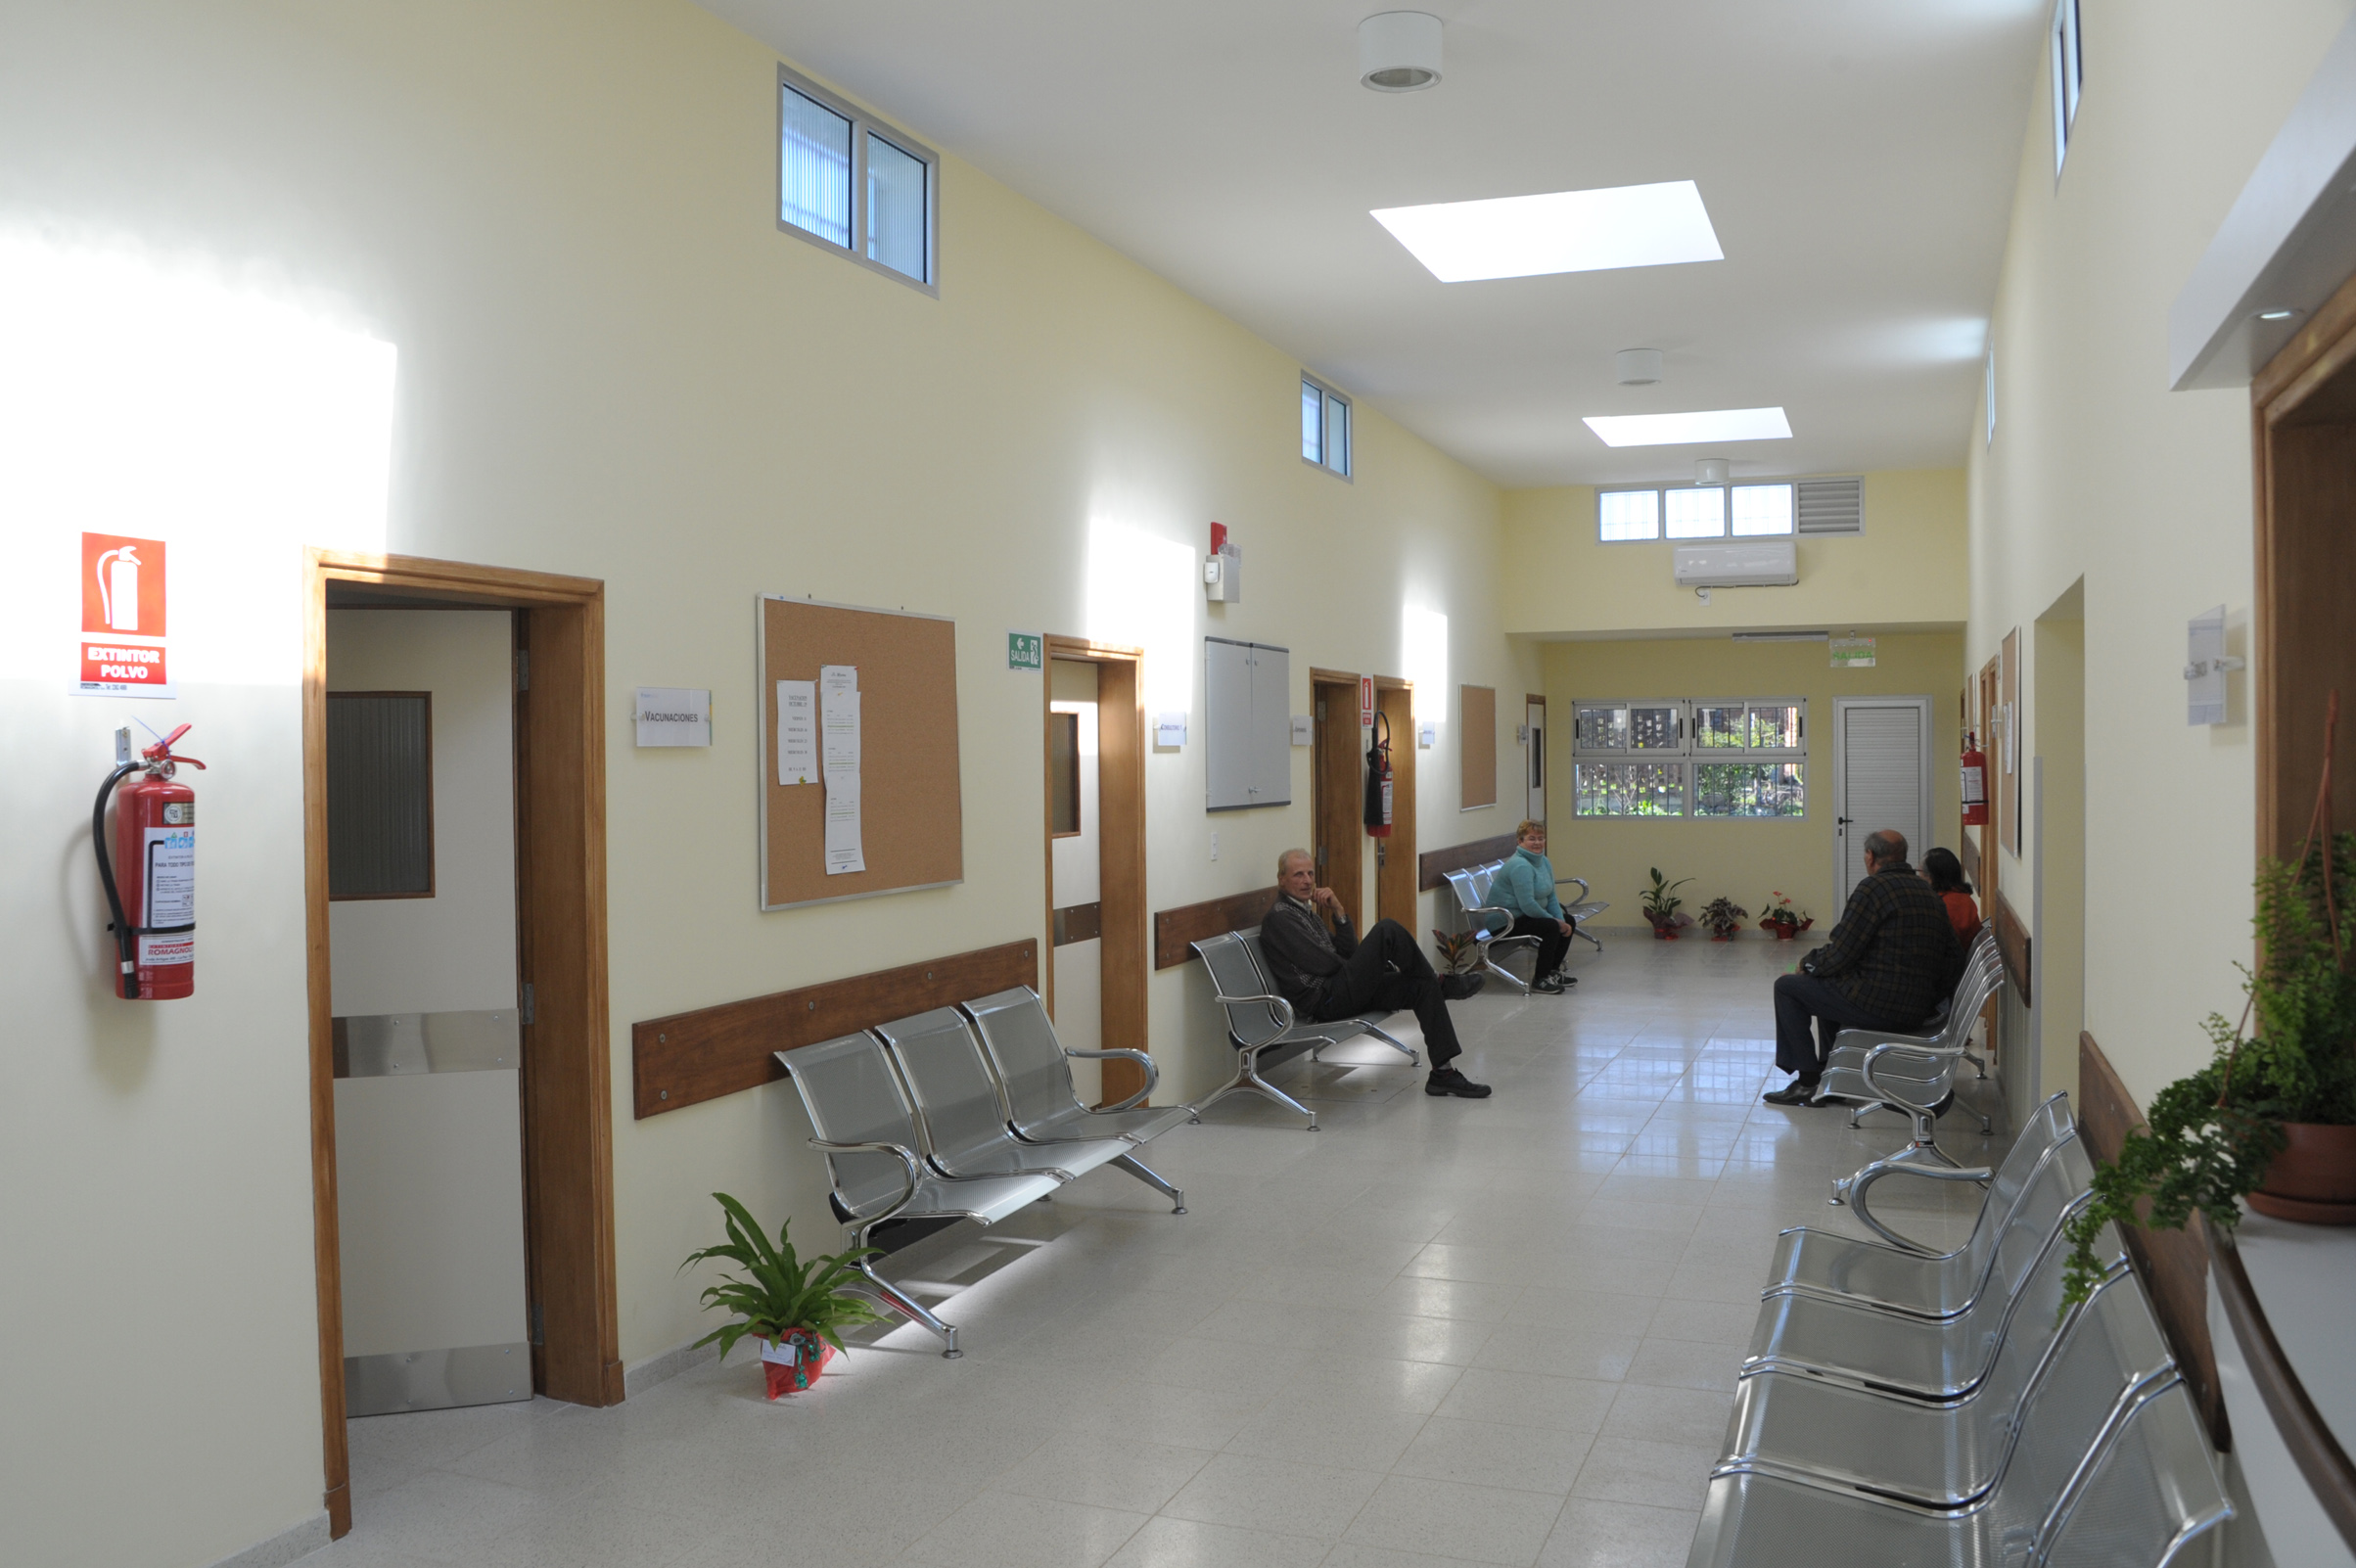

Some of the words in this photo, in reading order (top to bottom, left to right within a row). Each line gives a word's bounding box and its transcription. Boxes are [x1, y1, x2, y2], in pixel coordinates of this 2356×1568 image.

[87, 646, 161, 664] EXTINTOR
[1010, 649, 1031, 663] SALIDA
[1832, 650, 1872, 660] SALIDA
[100, 664, 149, 679] POLVO
[644, 711, 699, 722] VACUNACIONES
